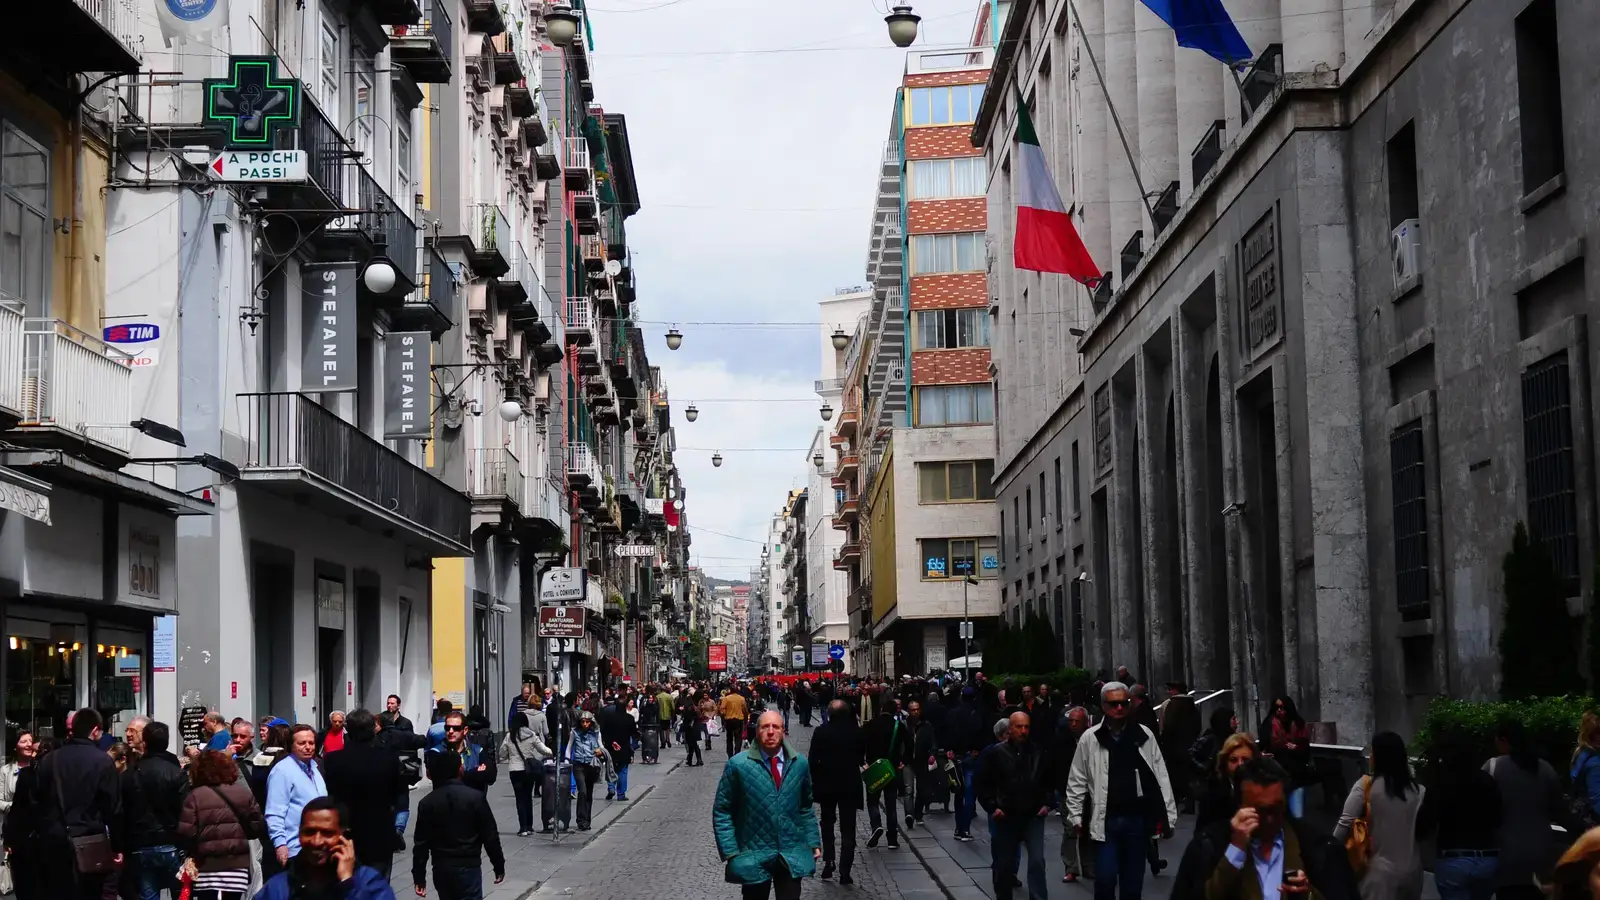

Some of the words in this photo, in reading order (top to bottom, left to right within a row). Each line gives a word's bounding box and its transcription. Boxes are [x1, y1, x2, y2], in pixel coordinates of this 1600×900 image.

[228, 153, 240, 164] A
[249, 152, 298, 164] POCHI
[239, 167, 287, 178] PASSI
[128, 326, 154, 339] TIM
[322, 270, 337, 386] STEFANEL
[402, 336, 414, 433] STEFANEL
[620, 544, 654, 556] PELLICCE
[926, 557, 945, 571] fabi
[543, 590, 555, 598] HOTEL
[560, 588, 580, 597] CONVENTO
